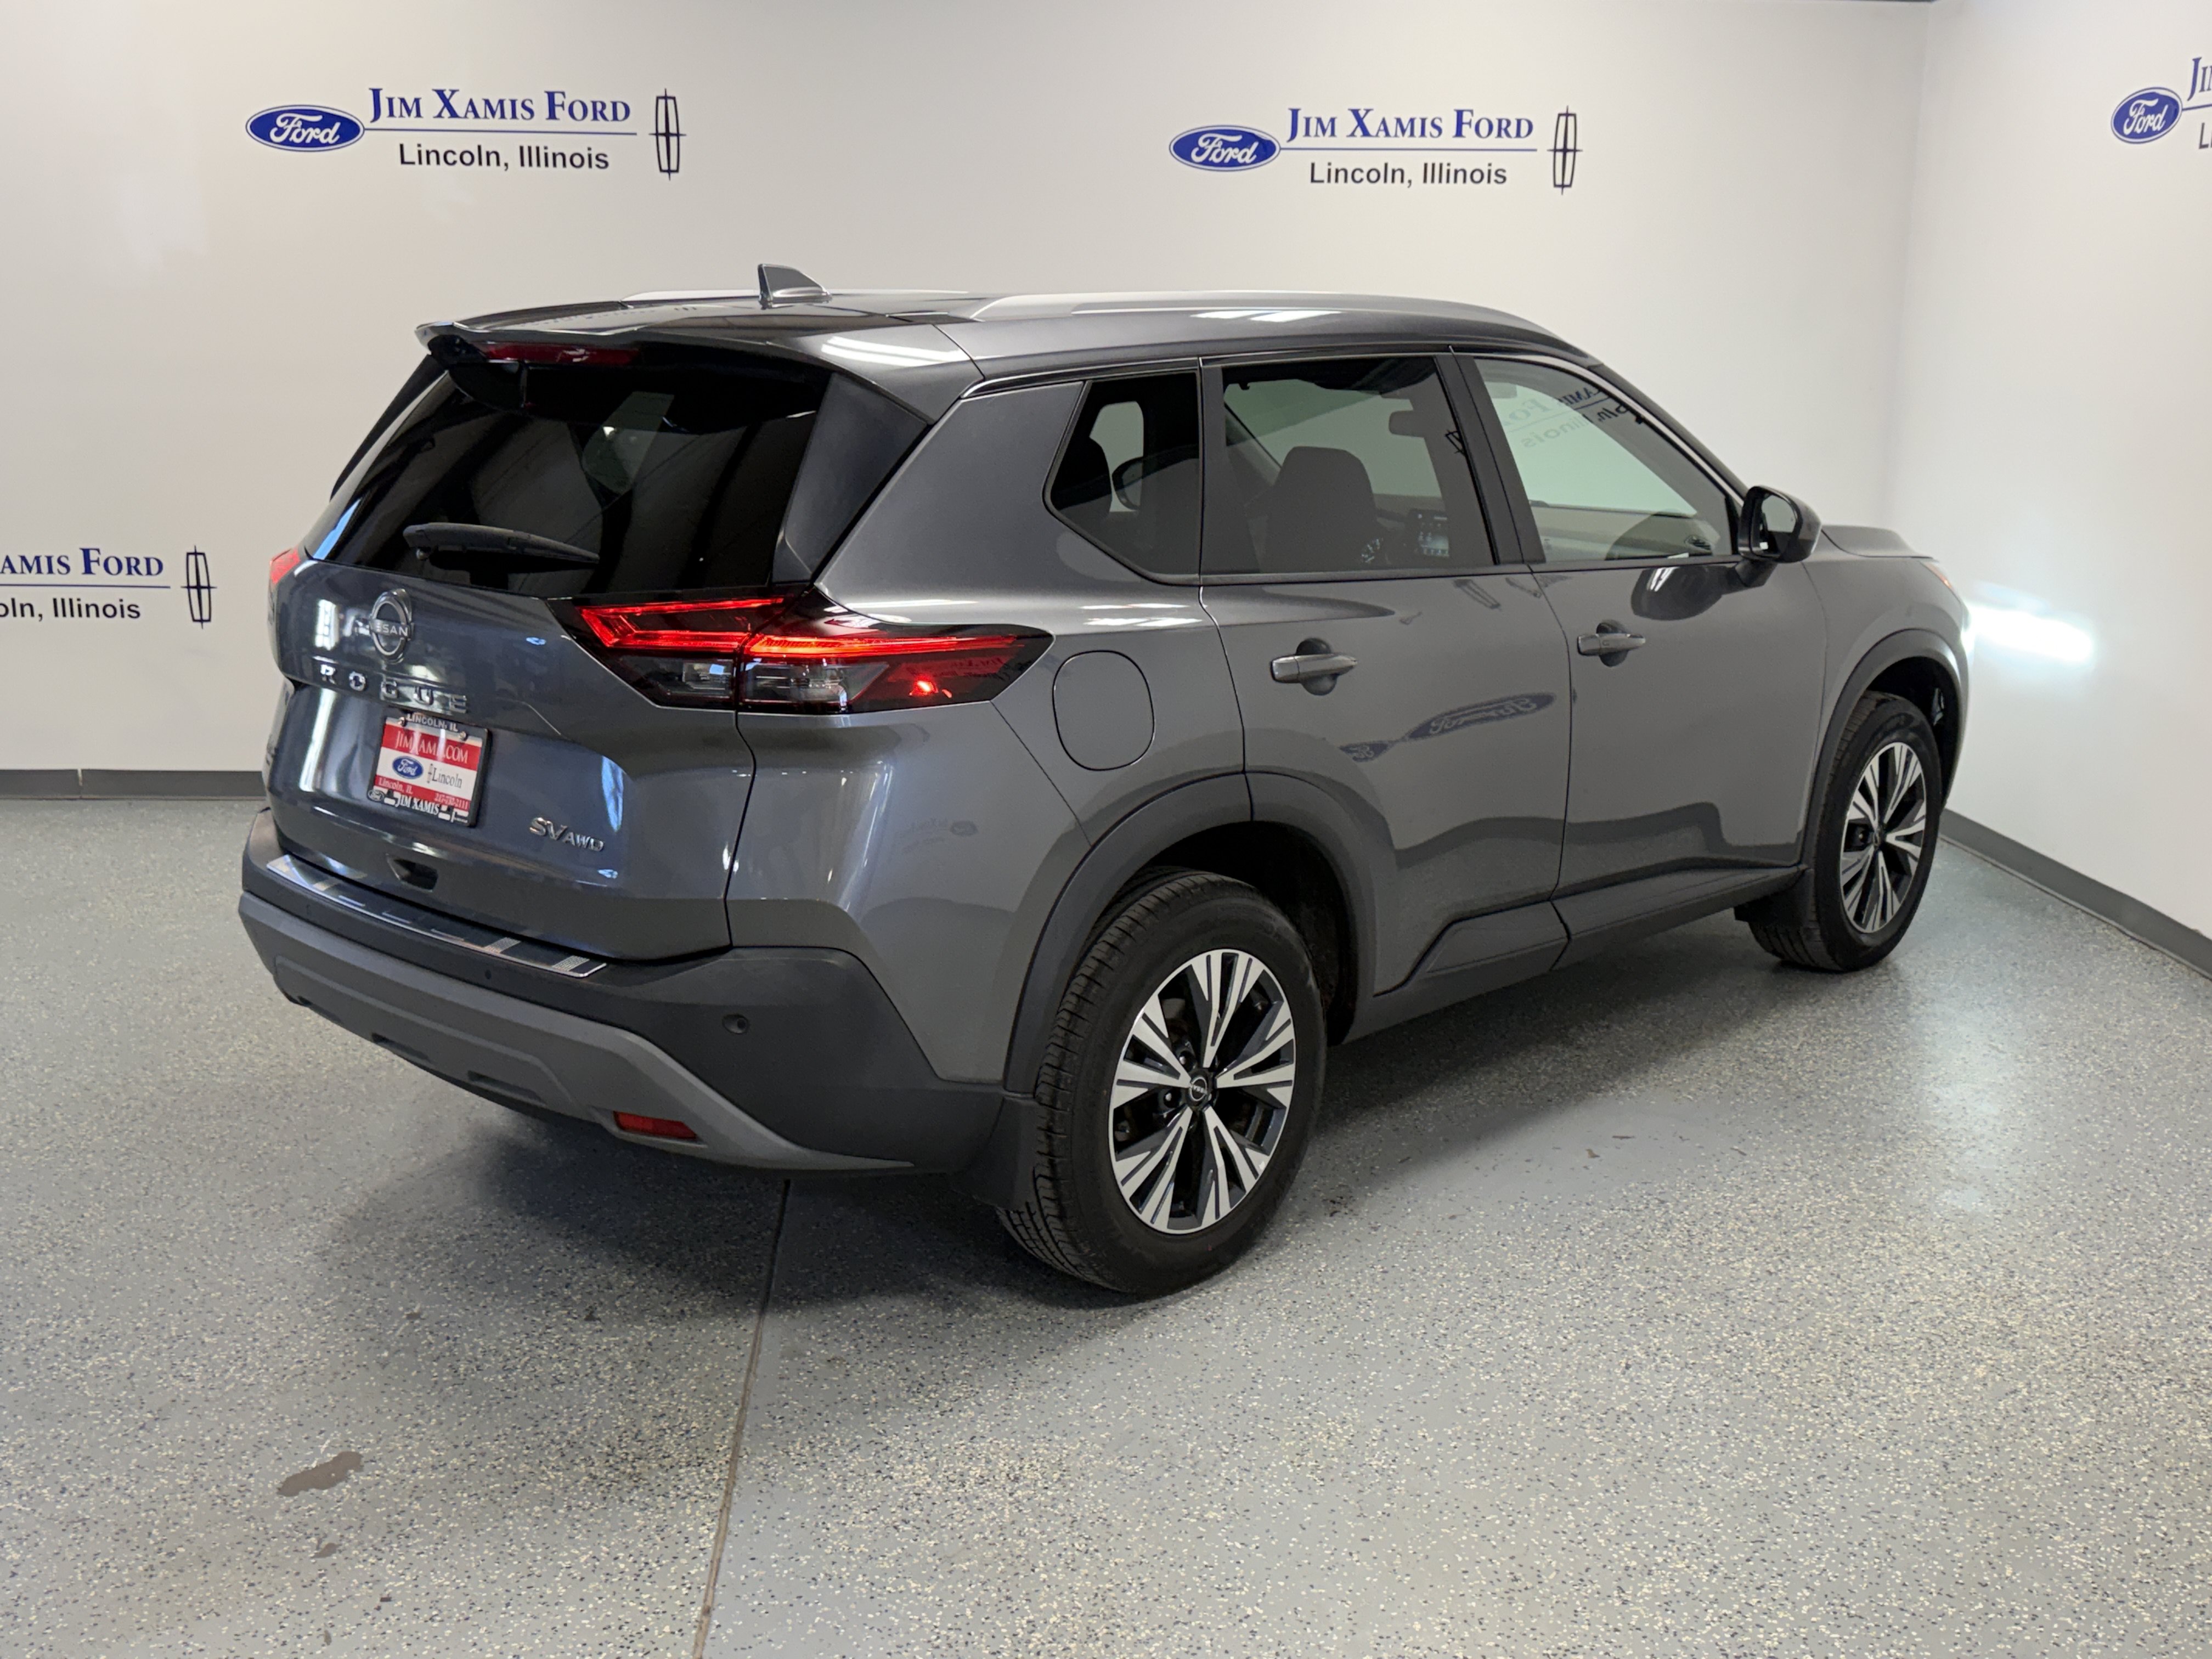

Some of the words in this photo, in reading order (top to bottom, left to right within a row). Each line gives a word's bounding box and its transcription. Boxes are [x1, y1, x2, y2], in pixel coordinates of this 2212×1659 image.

[369, 88, 422, 123] JIM
[432, 89, 535, 120] XAMIS
[545, 91, 630, 122] FORD
[2123, 98, 2169, 136] Ford
[269, 112, 341, 144] Ford
[1286, 108, 1336, 143] JIM
[1346, 109, 1443, 138] XAMIS
[1453, 109, 1533, 138] FORD
[399, 143, 509, 171] Lincoln,
[520, 145, 609, 170] Illinois
[1191, 133, 1259, 163] Ford
[1311, 162, 1412, 188] Lincoln,
[1423, 162, 1507, 184] Illinois
[80, 548, 163, 576] FORD
[53, 597, 141, 619] Illinois
[320, 663, 466, 713] ROGUE
[450, 722, 459, 732] IL
[395, 730, 469, 764] JIMXAM.COM
[398, 759, 418, 776] Ford
[432, 767, 462, 789] Lincoln
[395, 793, 412, 808] JIM
[412, 797, 439, 815] XAMIS
[529, 817, 568, 840] SV
[562, 831, 604, 852] AWD
